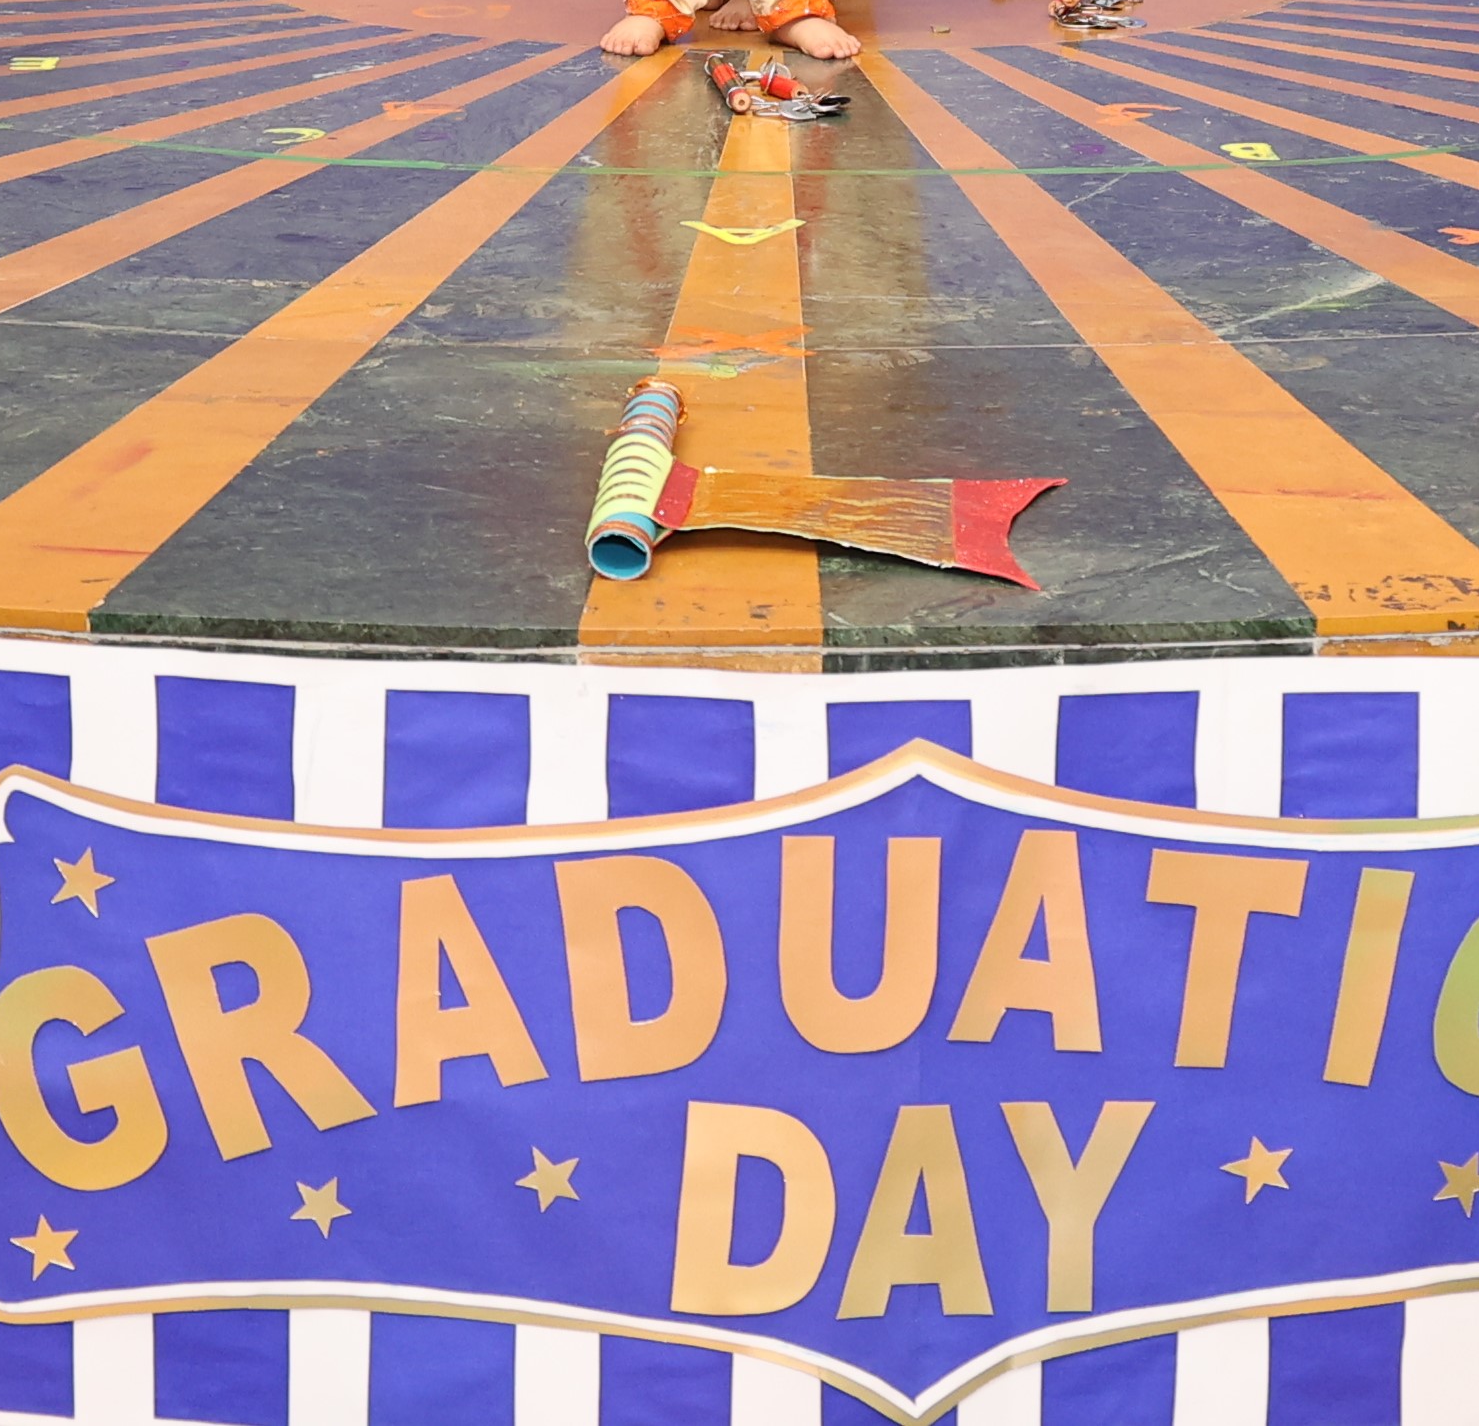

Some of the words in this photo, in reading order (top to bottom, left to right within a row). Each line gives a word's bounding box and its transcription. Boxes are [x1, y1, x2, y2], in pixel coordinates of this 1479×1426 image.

[9, 56, 61, 71] E
[1219, 142, 1280, 161] B
[671, 1101, 1154, 1319] DAY
